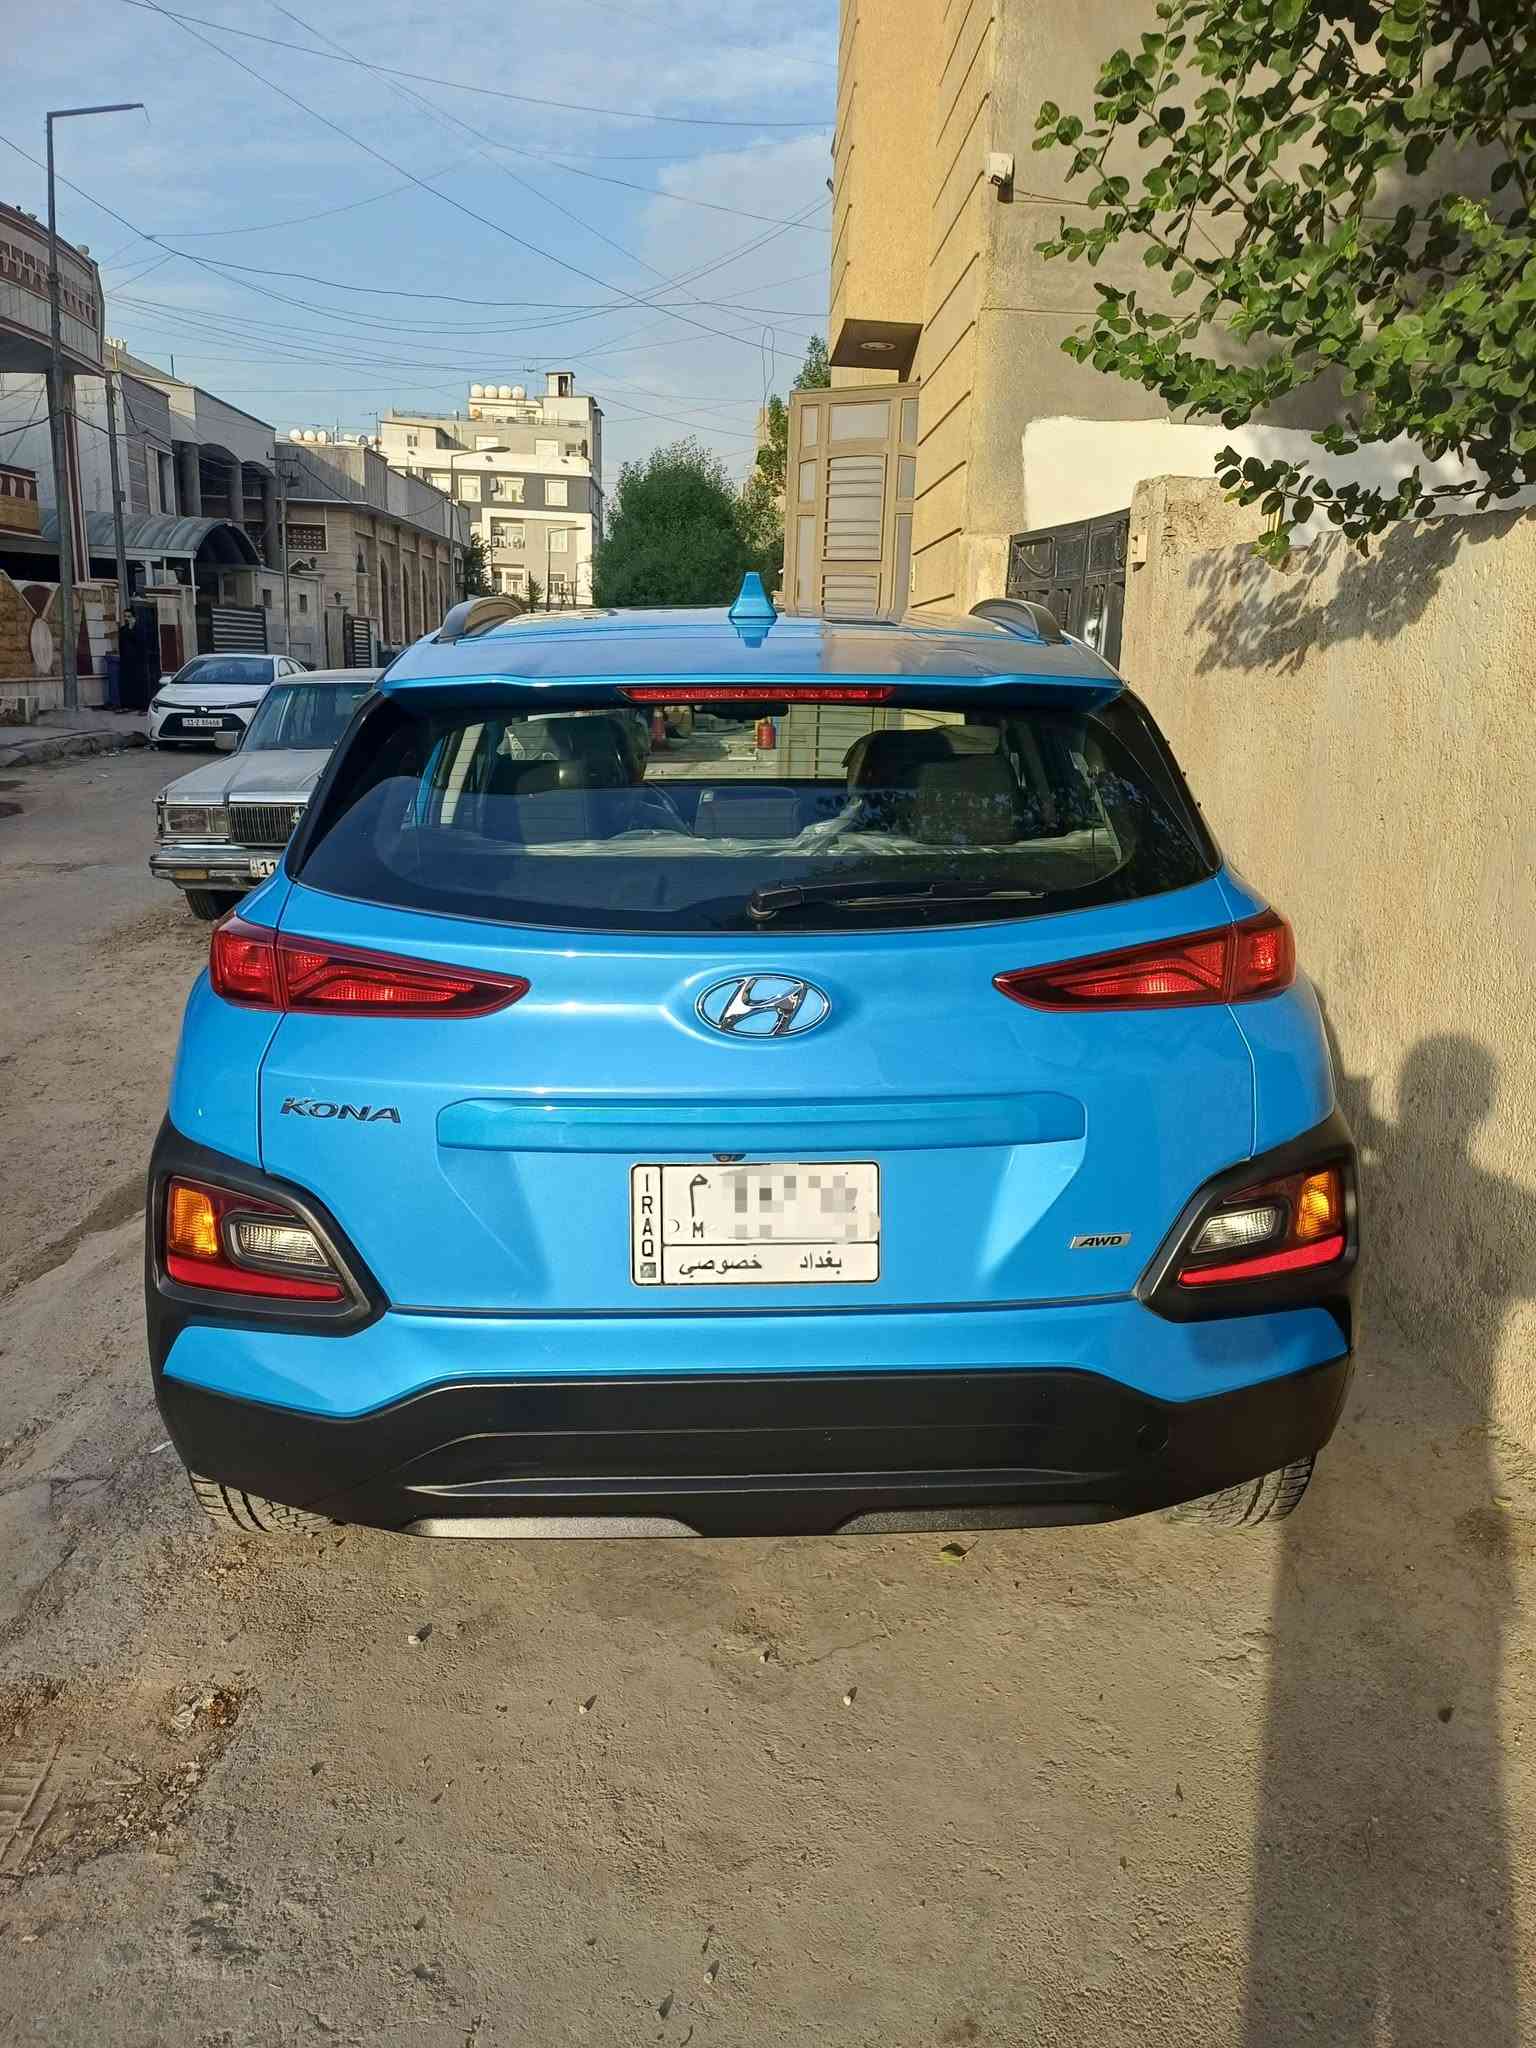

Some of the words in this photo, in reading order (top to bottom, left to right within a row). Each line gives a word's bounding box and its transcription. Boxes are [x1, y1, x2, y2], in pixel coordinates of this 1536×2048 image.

[280, 1097, 401, 1124] KONA
[641, 1173, 654, 1258] IRAQ
[692, 1221, 704, 1239] M
[1079, 1235, 1122, 1247] AWD
[679, 1253, 763, 1279] خصوصي
[799, 1249, 843, 1275] بغداد
